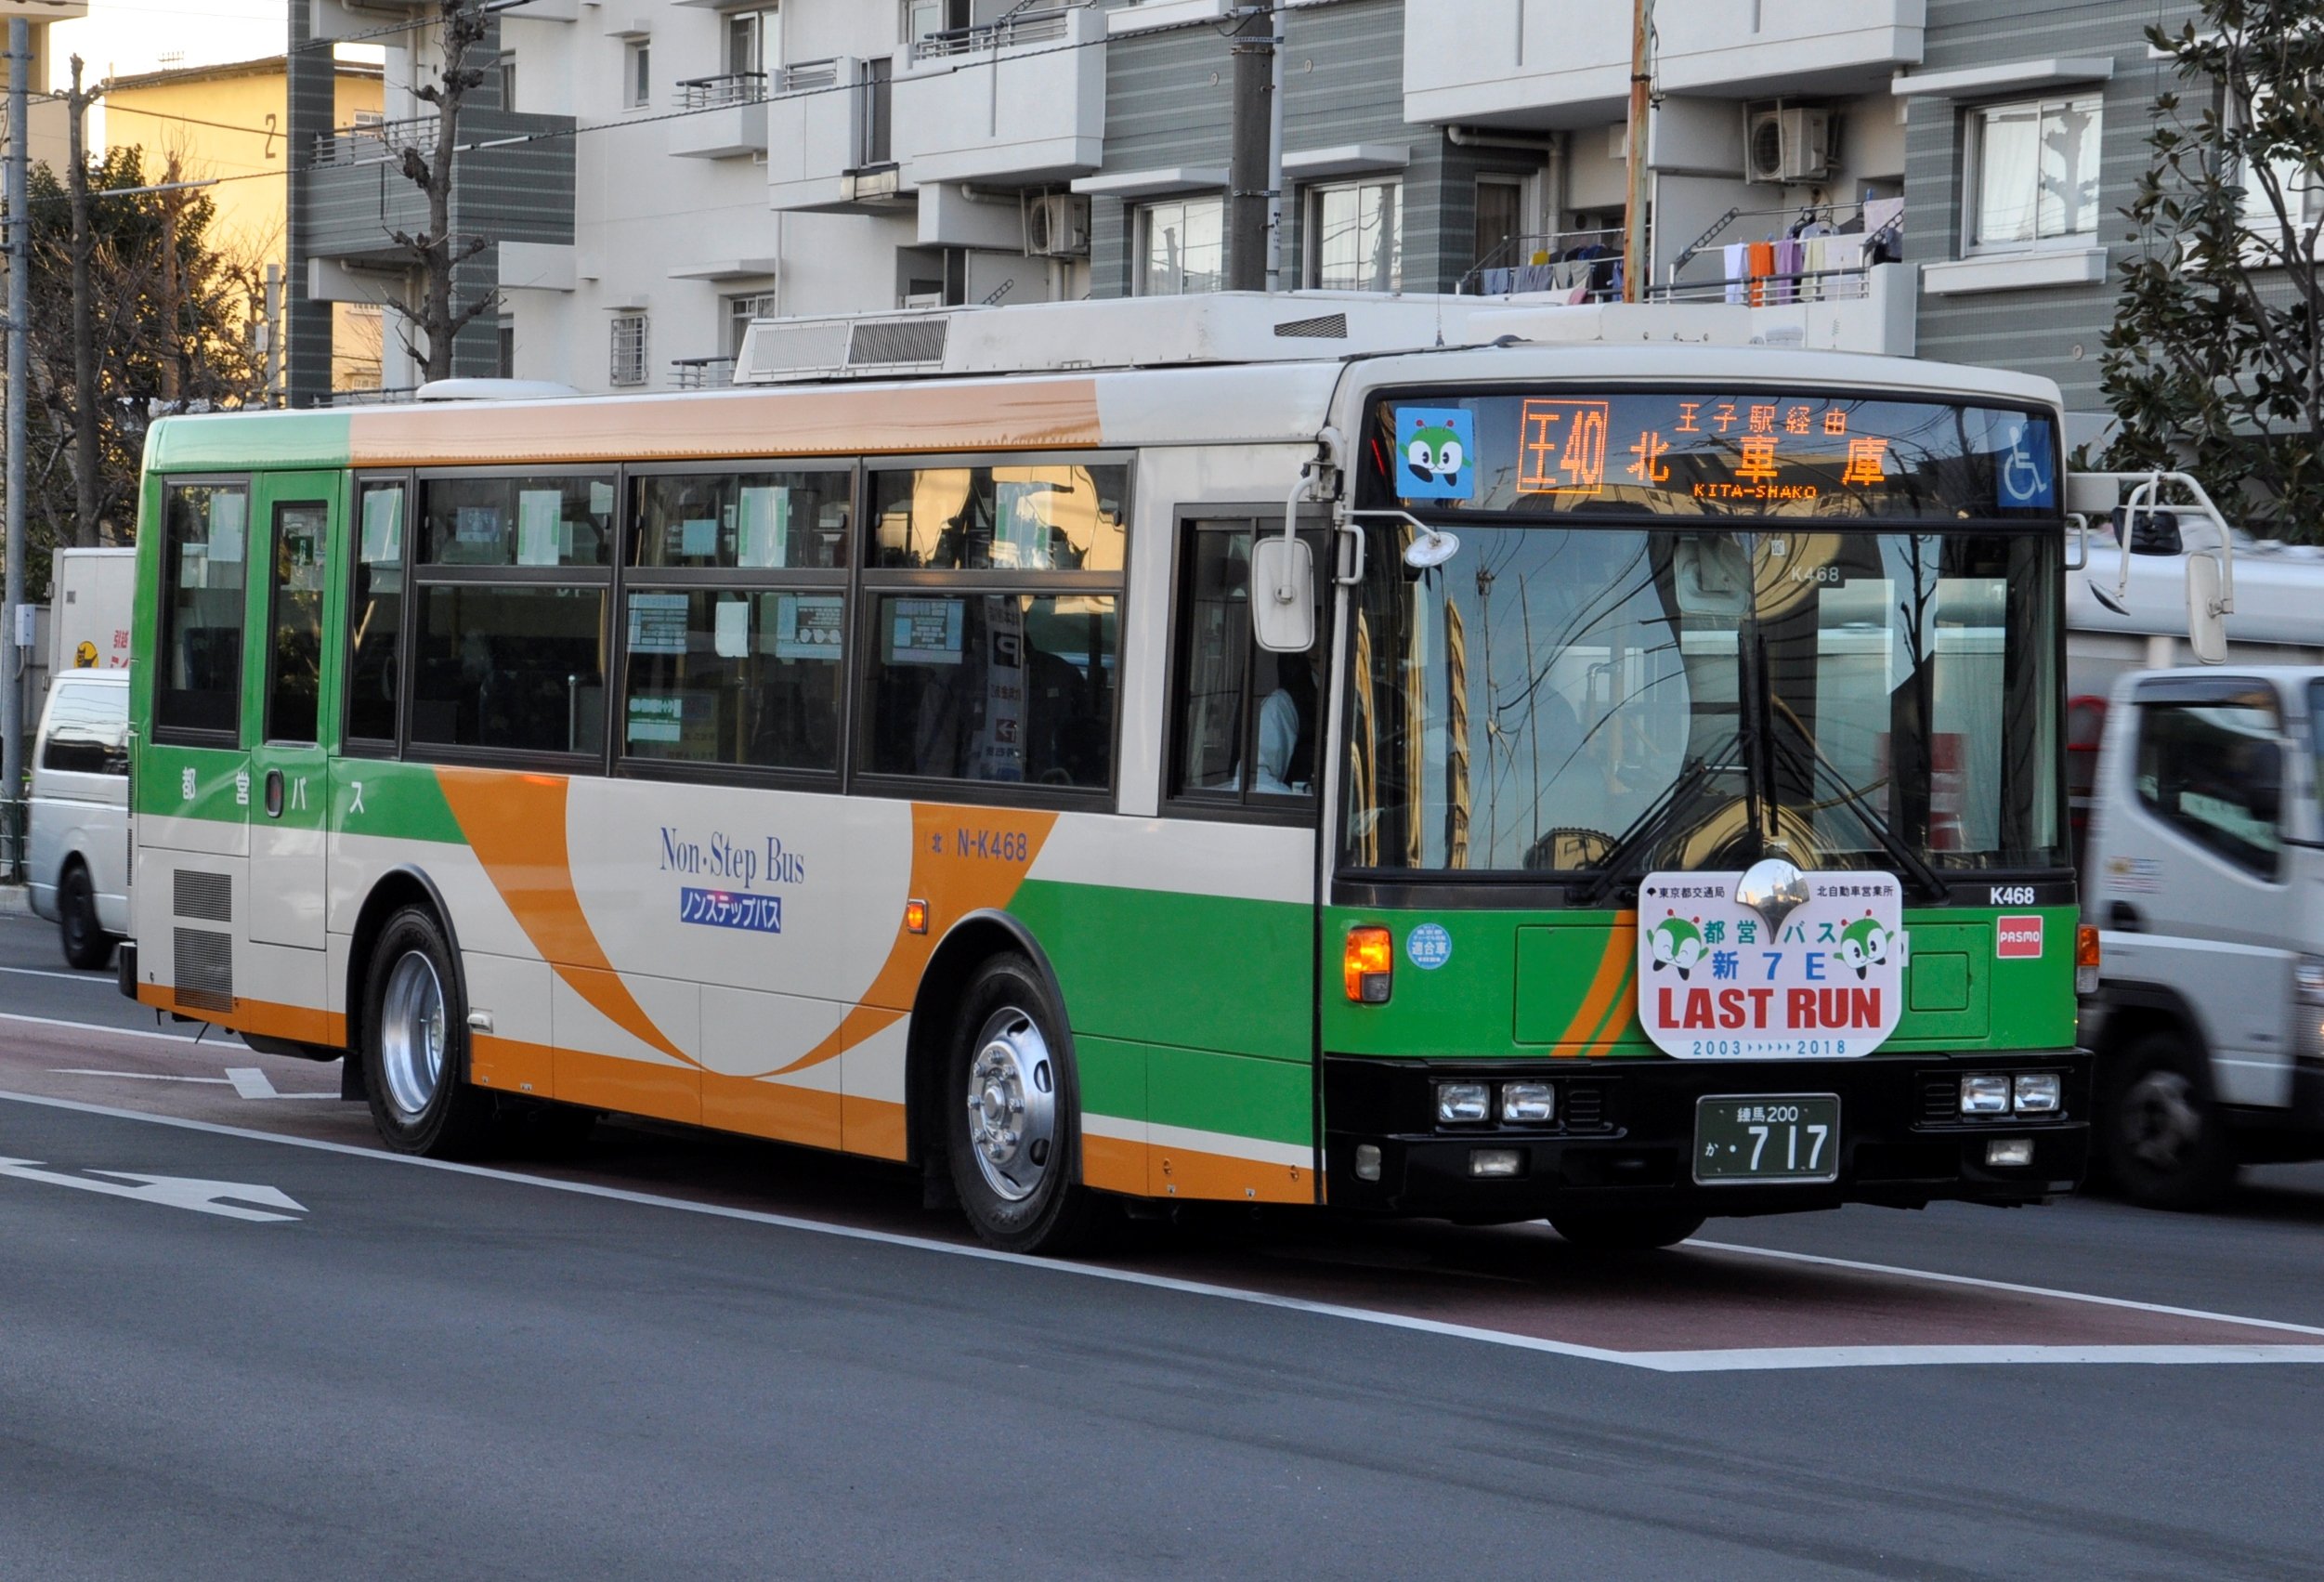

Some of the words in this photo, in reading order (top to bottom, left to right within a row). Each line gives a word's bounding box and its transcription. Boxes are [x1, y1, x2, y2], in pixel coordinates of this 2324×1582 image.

[265, 113, 277, 159] 2
[1676, 402, 1847, 436] 王子駅経由
[1693, 483, 1818, 499] KITA-SHAKO
[1791, 566, 1840, 583] K468
[958, 828, 1027, 863] N-K468
[765, 835, 805, 884] Bus
[1658, 886, 1726, 899] 東京都交通局
[1817, 885, 1894, 897] 北自動車営業所
[1990, 886, 2035, 905] K468
[682, 891, 780, 930] ノンステップバス
[1999, 931, 2041, 944] PASMO
[1658, 987, 1774, 1030] LAST
[1786, 987, 1882, 1029] RUN
[1692, 1040, 1742, 1056] 2003
[1796, 1039, 1847, 1055] 2018
